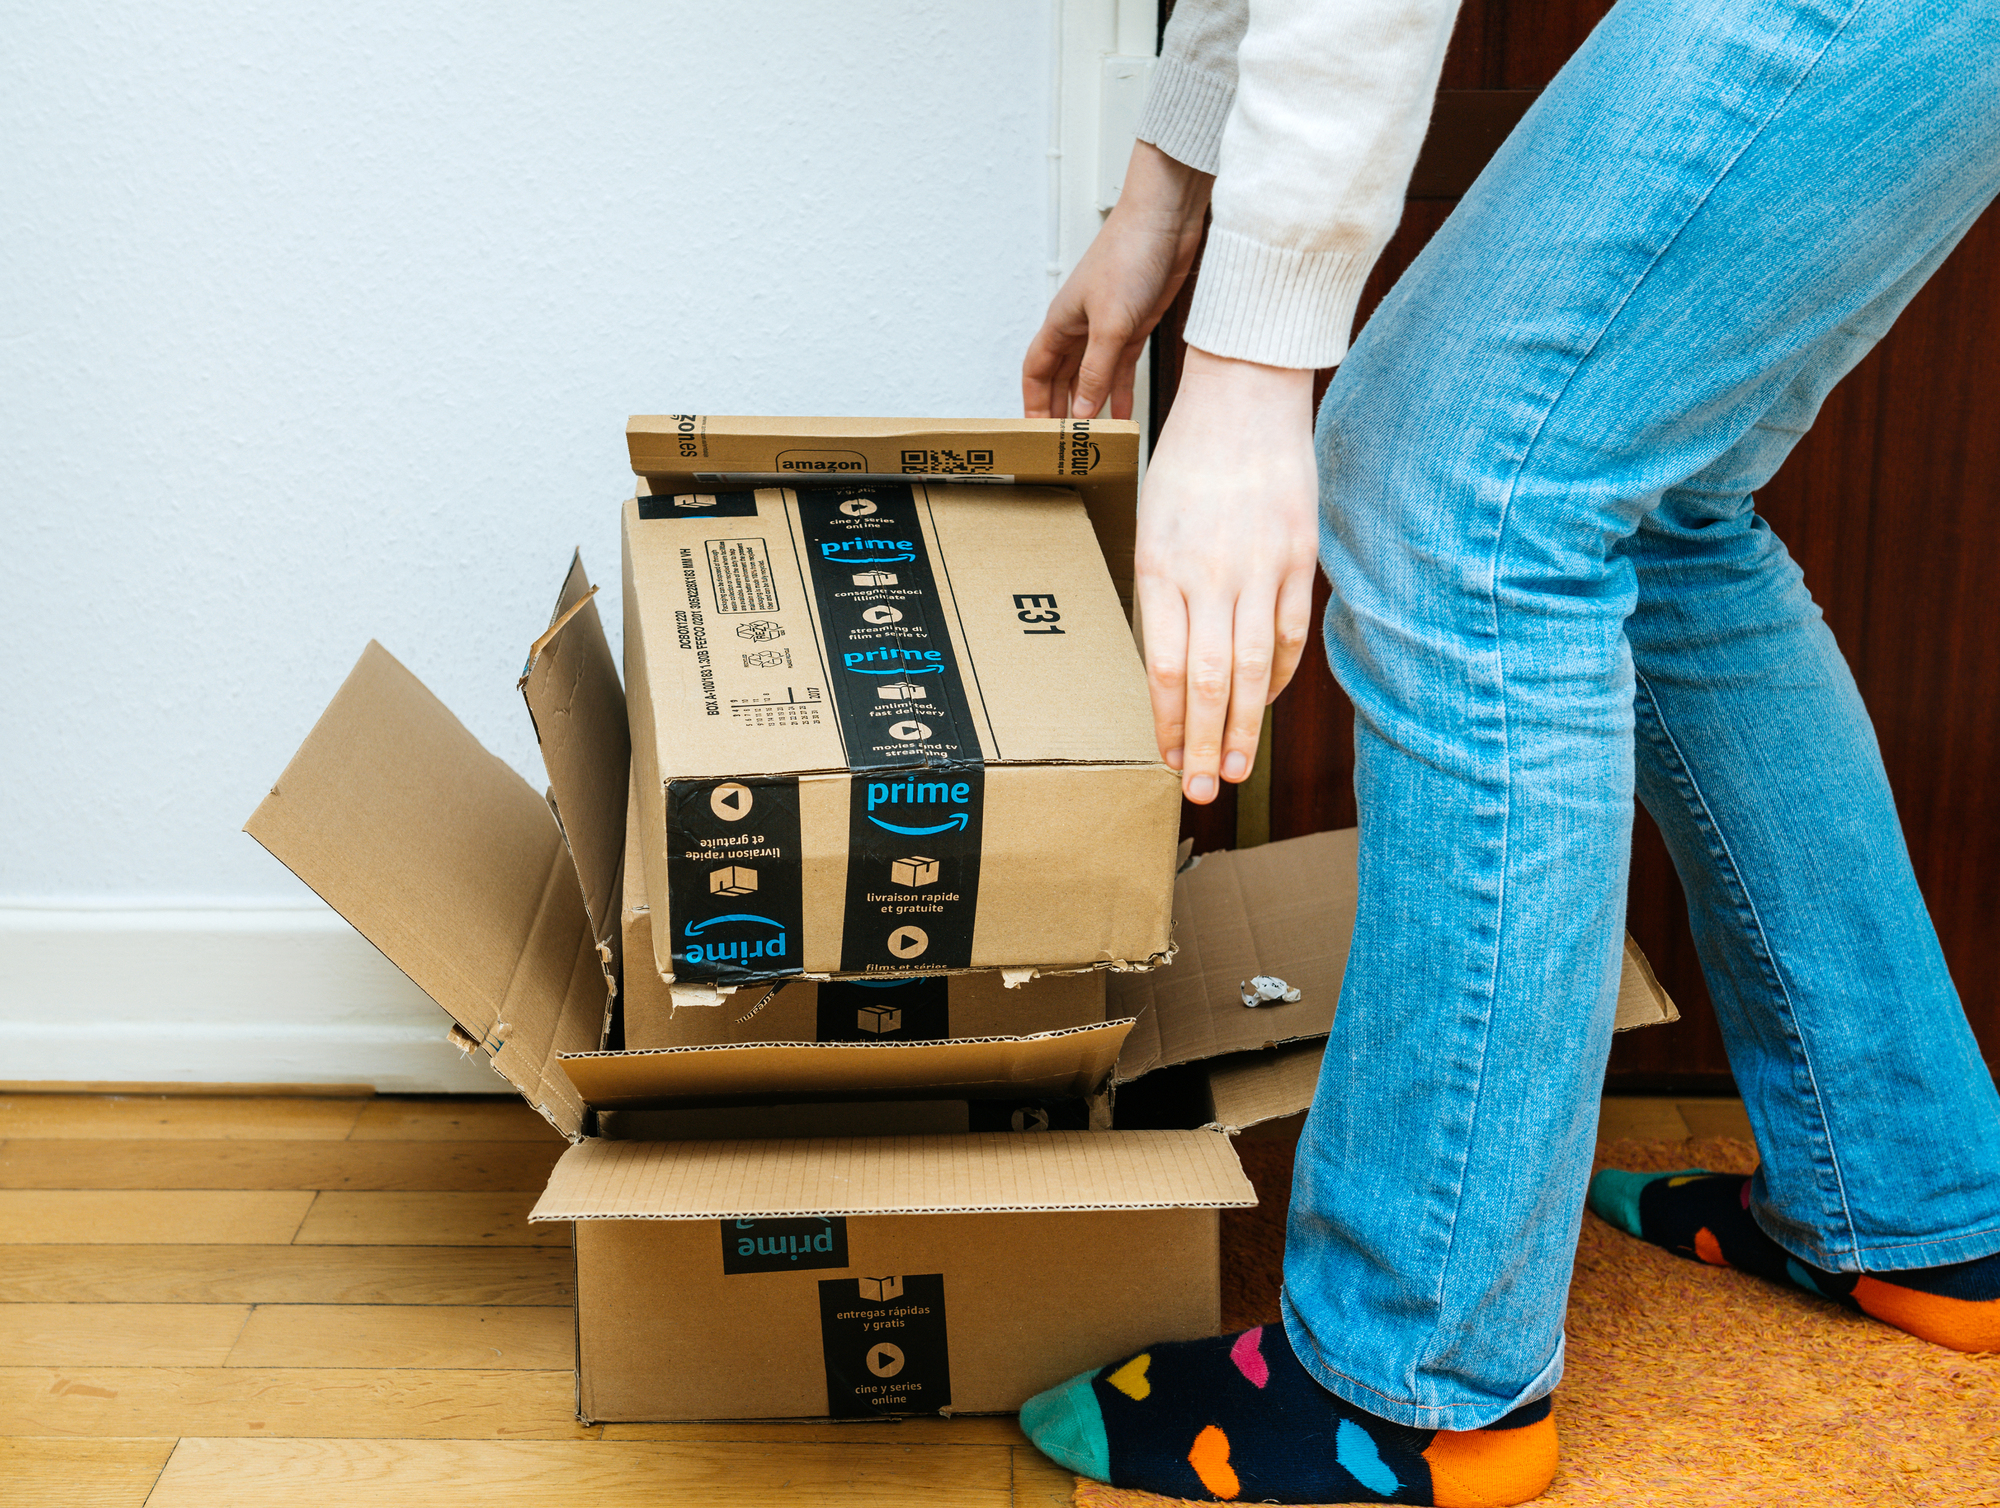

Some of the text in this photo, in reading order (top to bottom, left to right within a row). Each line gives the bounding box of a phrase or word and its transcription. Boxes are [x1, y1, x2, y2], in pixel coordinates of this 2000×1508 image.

[782, 461, 862, 470] amazon
[821, 537, 913, 556] prime
[1013, 594, 1066, 634] E31
[675, 610, 691, 649] DCBOX1220
[680, 548, 719, 716] BOX A-100/183 1.30B FEFCO 0201 305X228X183 MM VH
[851, 625, 908, 634] streaming
[844, 646, 941, 667] prime
[807, 687, 820, 699] 2017
[896, 707, 944, 716] delivery
[872, 743, 915, 751] movies
[885, 749, 948, 758] streaming
[868, 776, 970, 811] prime
[700, 833, 764, 847] et gratuite
[686, 848, 781, 862] livraison rapide
[867, 892, 960, 904] livraison rapide
[881, 904, 944, 914] et gratuite
[686, 932, 786, 966] prime
[866, 963, 896, 972] films
[738, 1227, 833, 1261] prime
[837, 1305, 930, 1320] entregas rápidas
[863, 1319, 905, 1331] y gratis
[855, 1382, 922, 1394] cine y series
[872, 1395, 907, 1405] online
